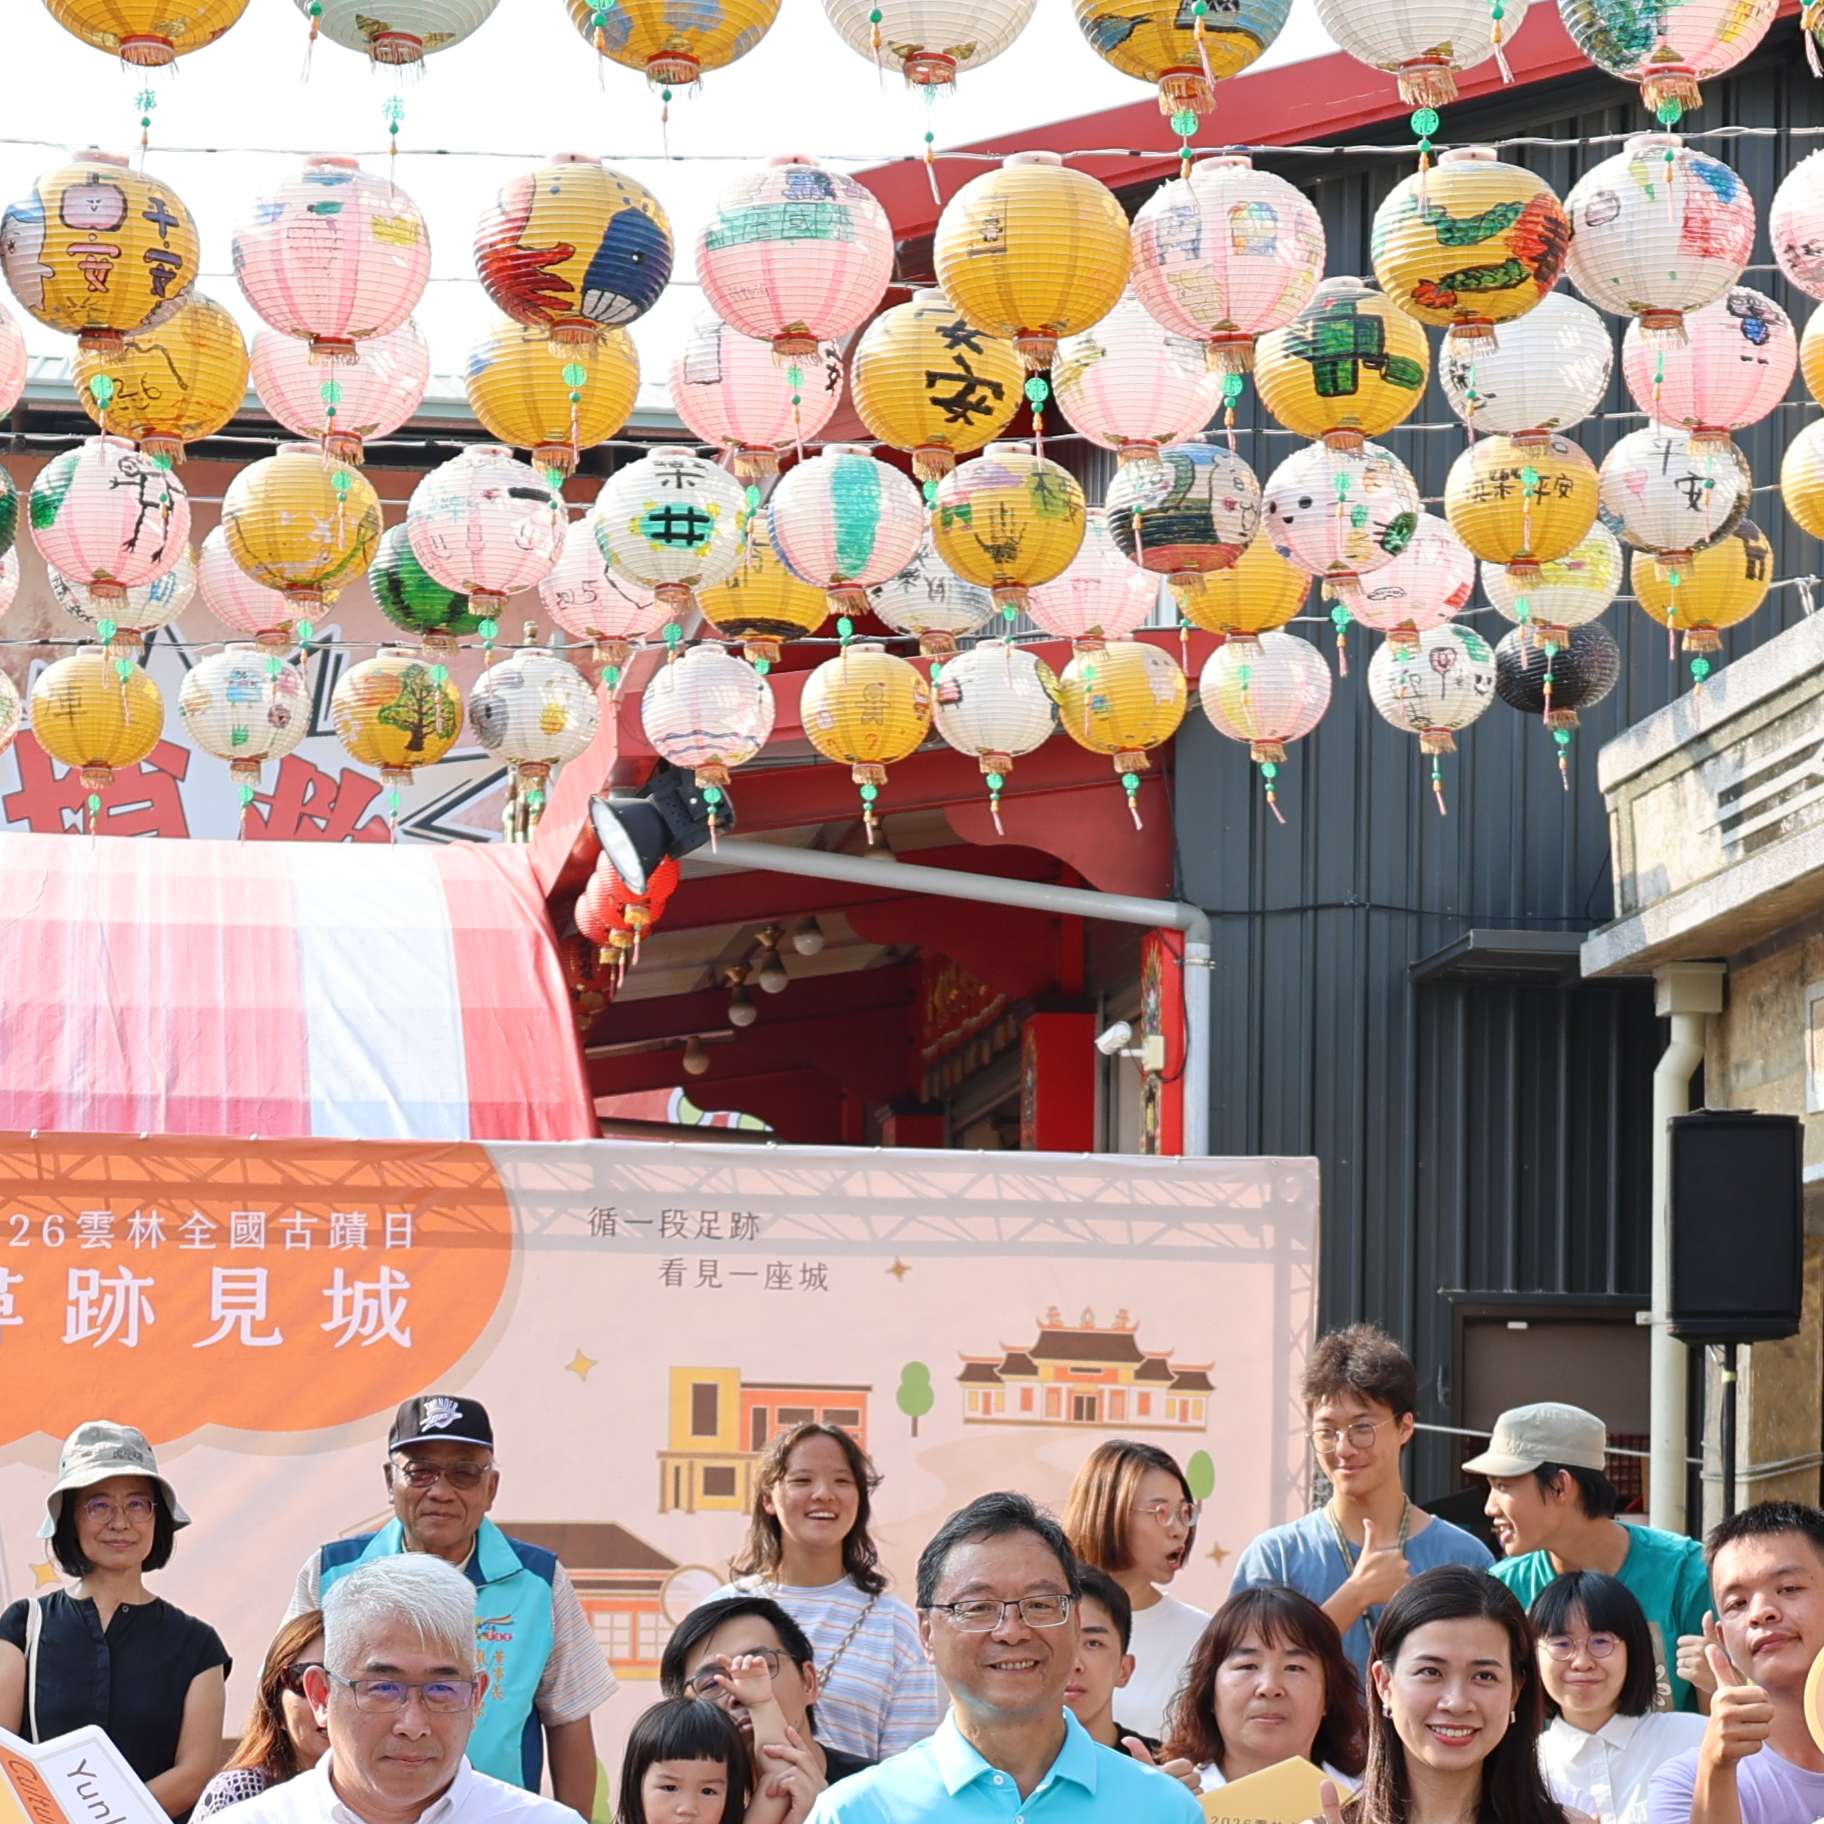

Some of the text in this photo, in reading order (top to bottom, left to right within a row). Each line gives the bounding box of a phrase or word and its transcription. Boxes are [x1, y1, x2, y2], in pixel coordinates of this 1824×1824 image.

[588, 1205, 760, 1242] 循一段足跡
[659, 1257, 829, 1293] 看見一座城
